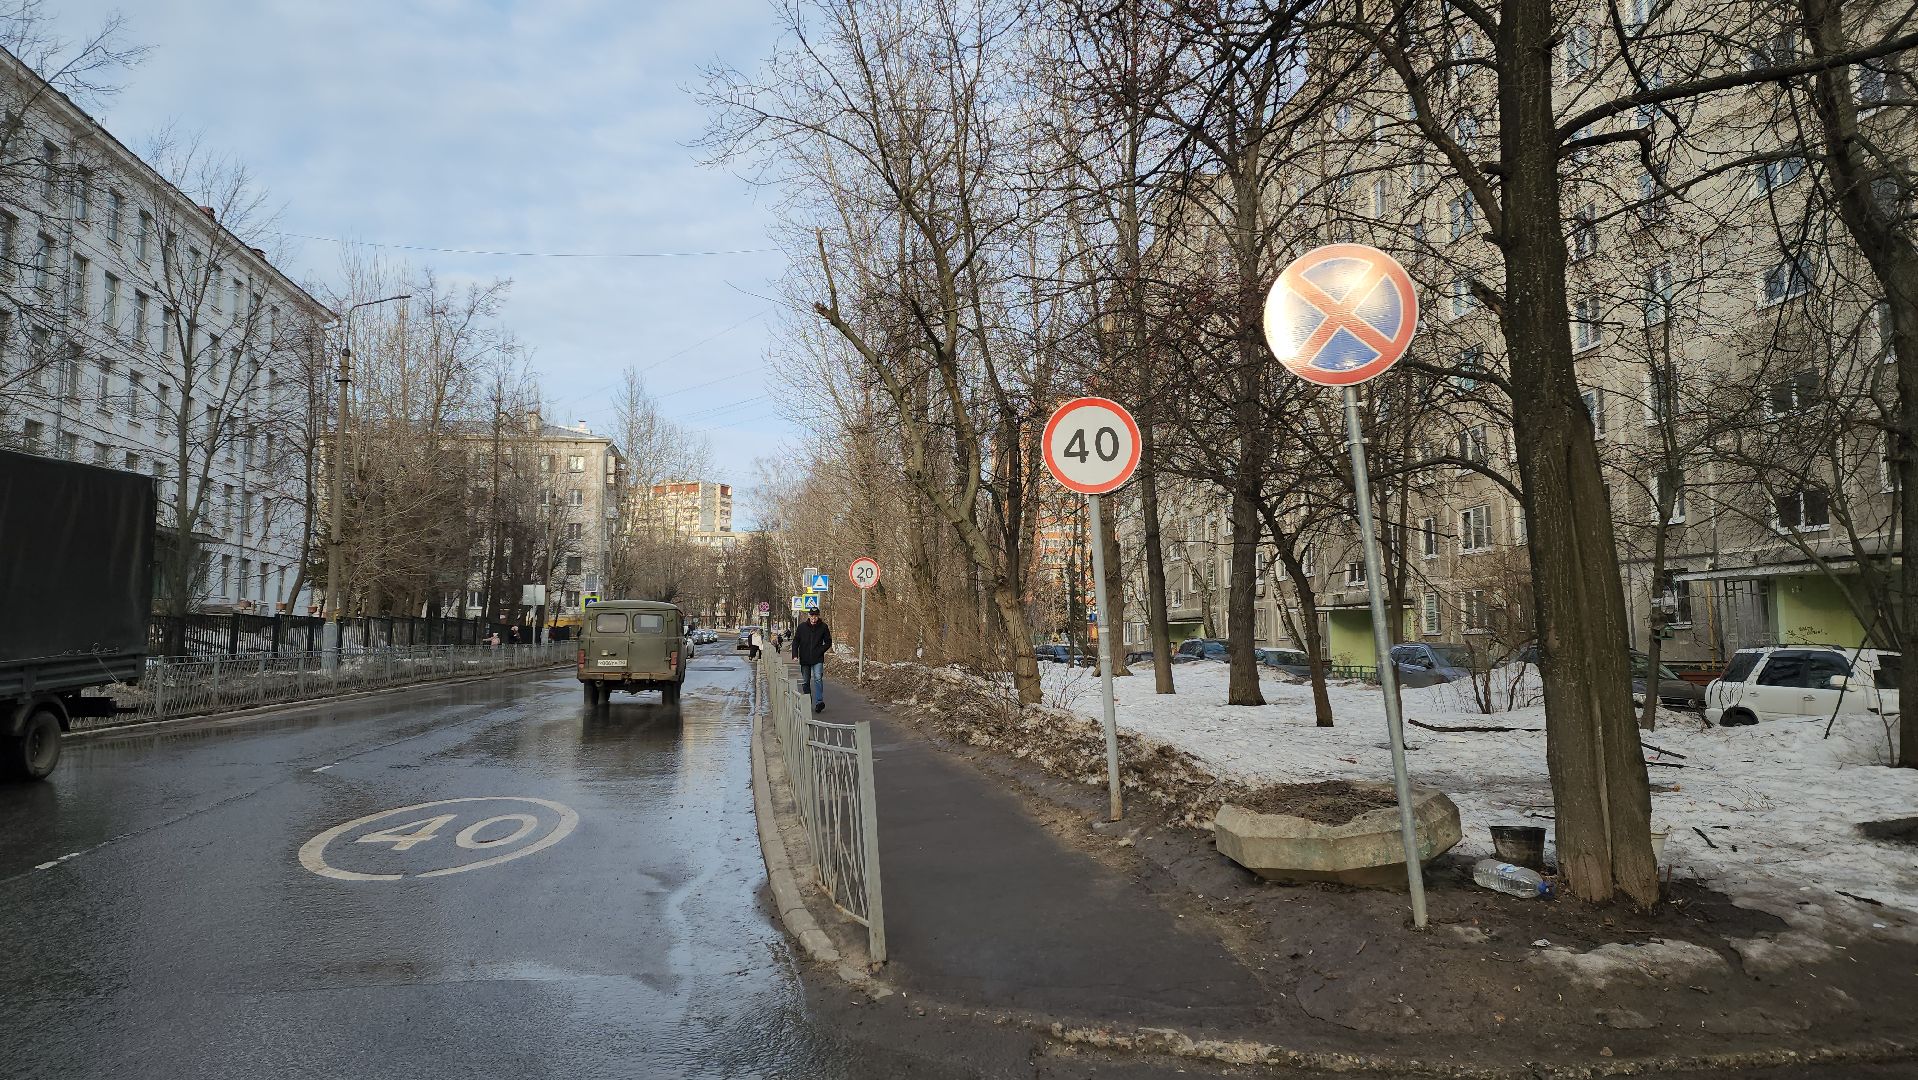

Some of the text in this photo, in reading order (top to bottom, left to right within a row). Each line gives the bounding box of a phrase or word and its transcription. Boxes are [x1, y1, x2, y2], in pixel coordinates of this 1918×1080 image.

[1063, 426, 1120, 464] 40
[857, 566, 874, 579] 20
[354, 813, 538, 851] 40
